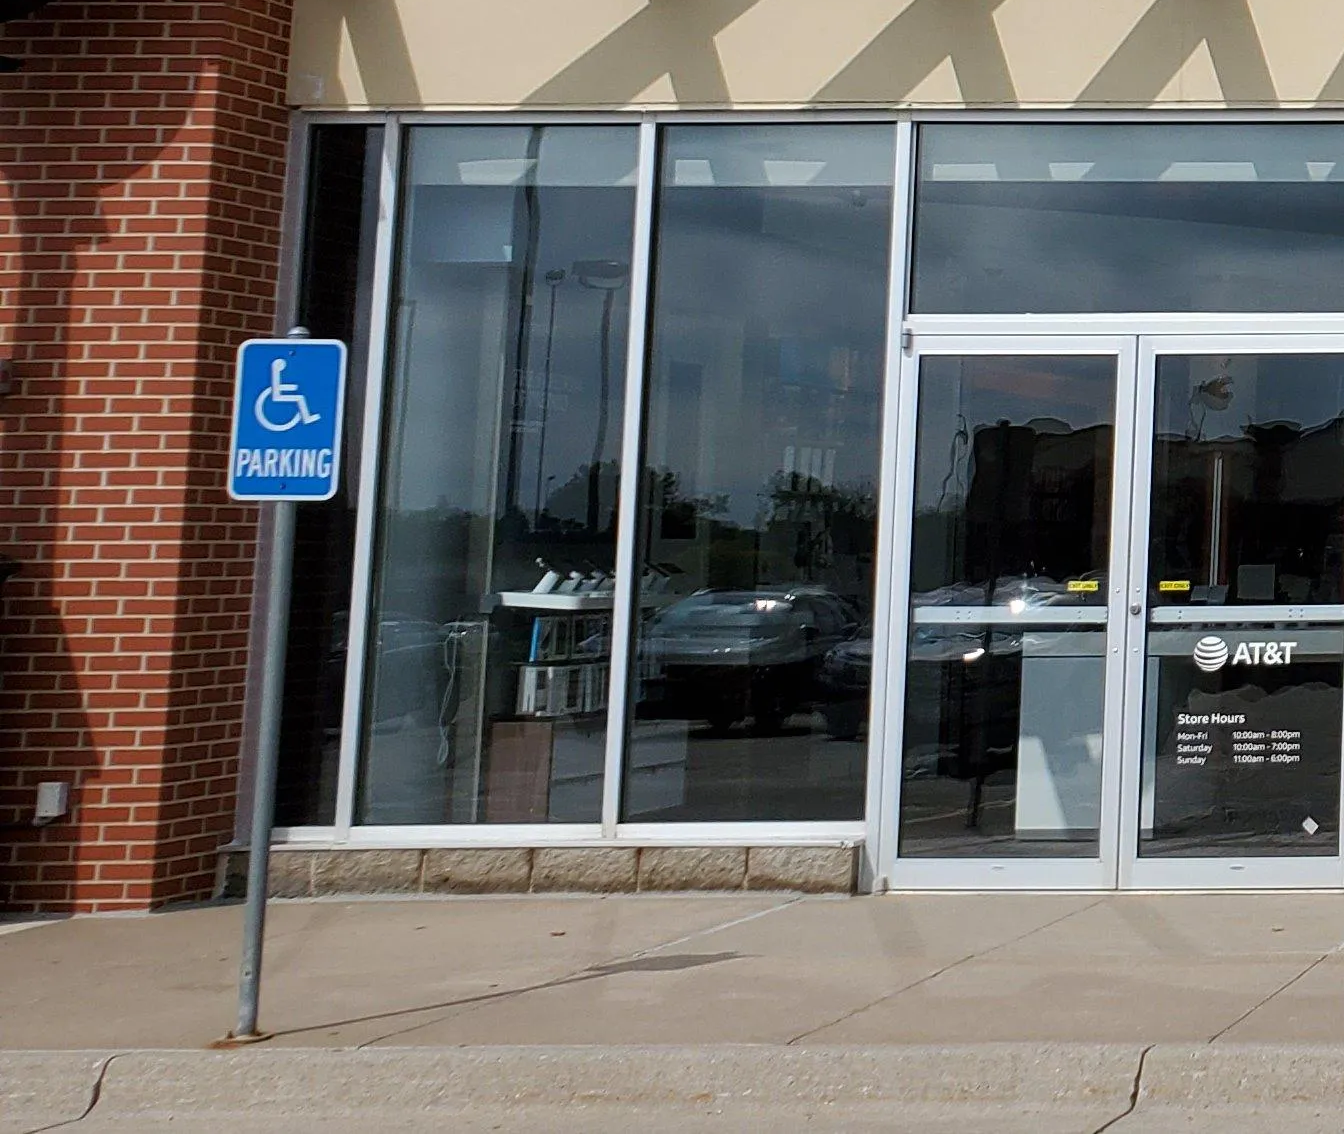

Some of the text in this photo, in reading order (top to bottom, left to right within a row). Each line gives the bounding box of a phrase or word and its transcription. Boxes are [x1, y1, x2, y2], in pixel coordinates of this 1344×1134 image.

[236, 448, 333, 479] PARKING
[1231, 641, 1298, 665] AT&T
[1177, 713, 1246, 725] Store Hours
[1177, 731, 1208, 740] Mon-Fri
[1232, 731, 1265, 740] 10:00am
[1271, 730, 1300, 740] 8:00pm
[1177, 743, 1213, 754] Saturday
[1233, 743, 1265, 751] 10:00am
[1271, 742, 1300, 752] 7:00pm
[1177, 755, 1207, 766] Sunday
[1233, 754, 1264, 763] 11:00am
[1270, 754, 1300, 764] 6:00pm
